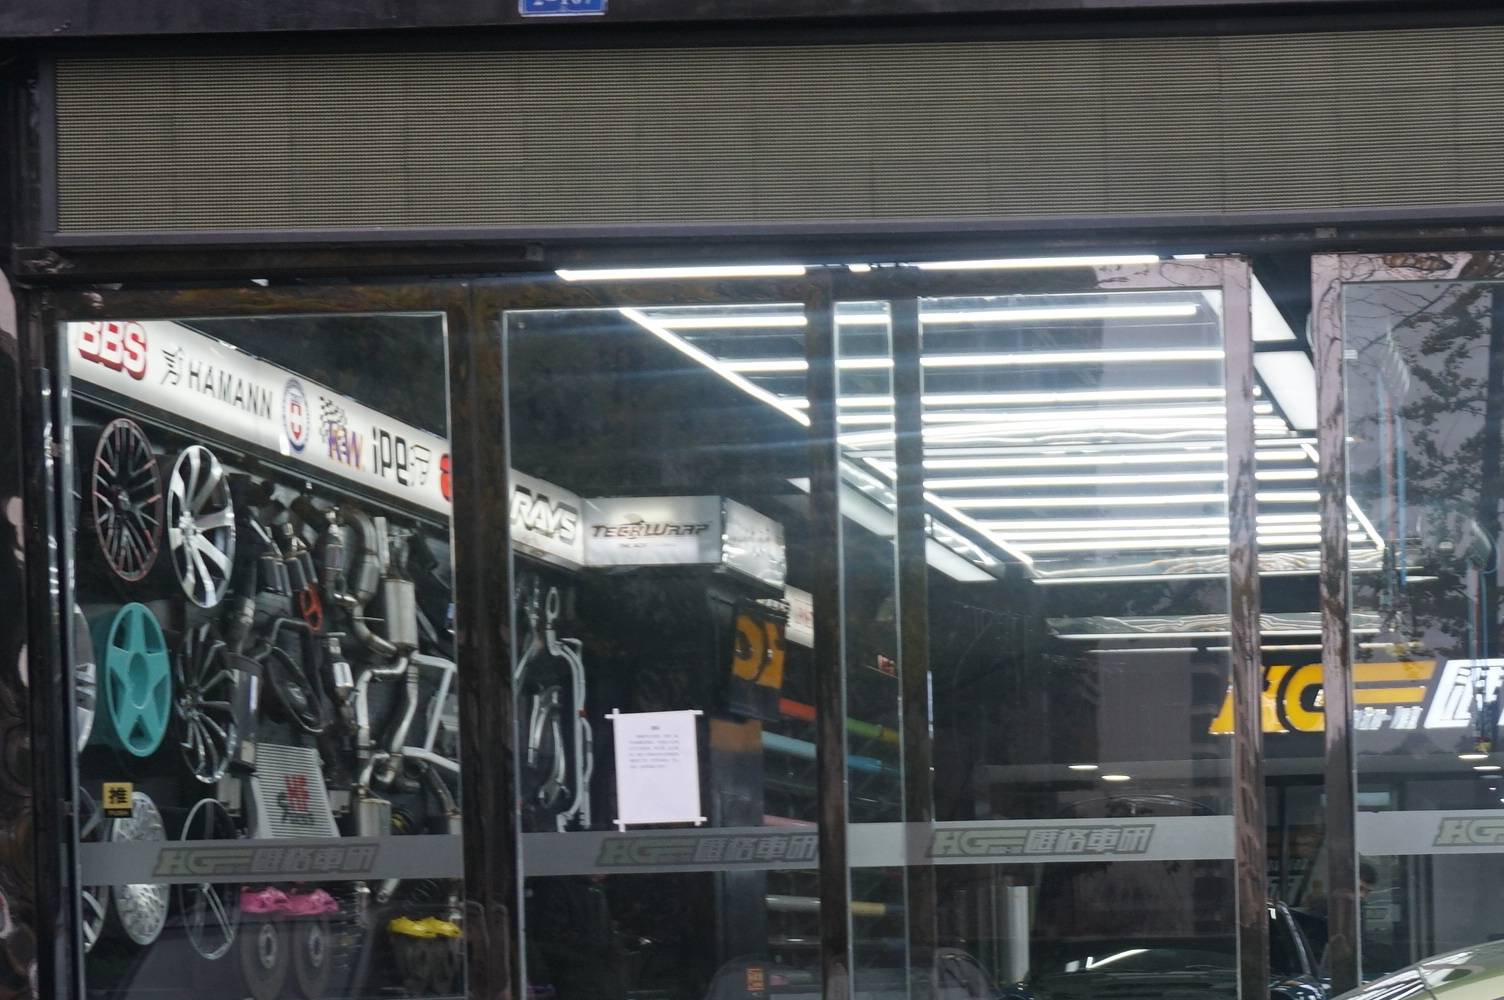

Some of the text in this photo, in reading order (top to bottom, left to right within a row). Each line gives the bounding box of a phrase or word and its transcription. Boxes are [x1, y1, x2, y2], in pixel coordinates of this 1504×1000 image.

[77, 321, 148, 380] BBS
[187, 360, 274, 420] HAMANN
[510, 485, 578, 546] RAYS
